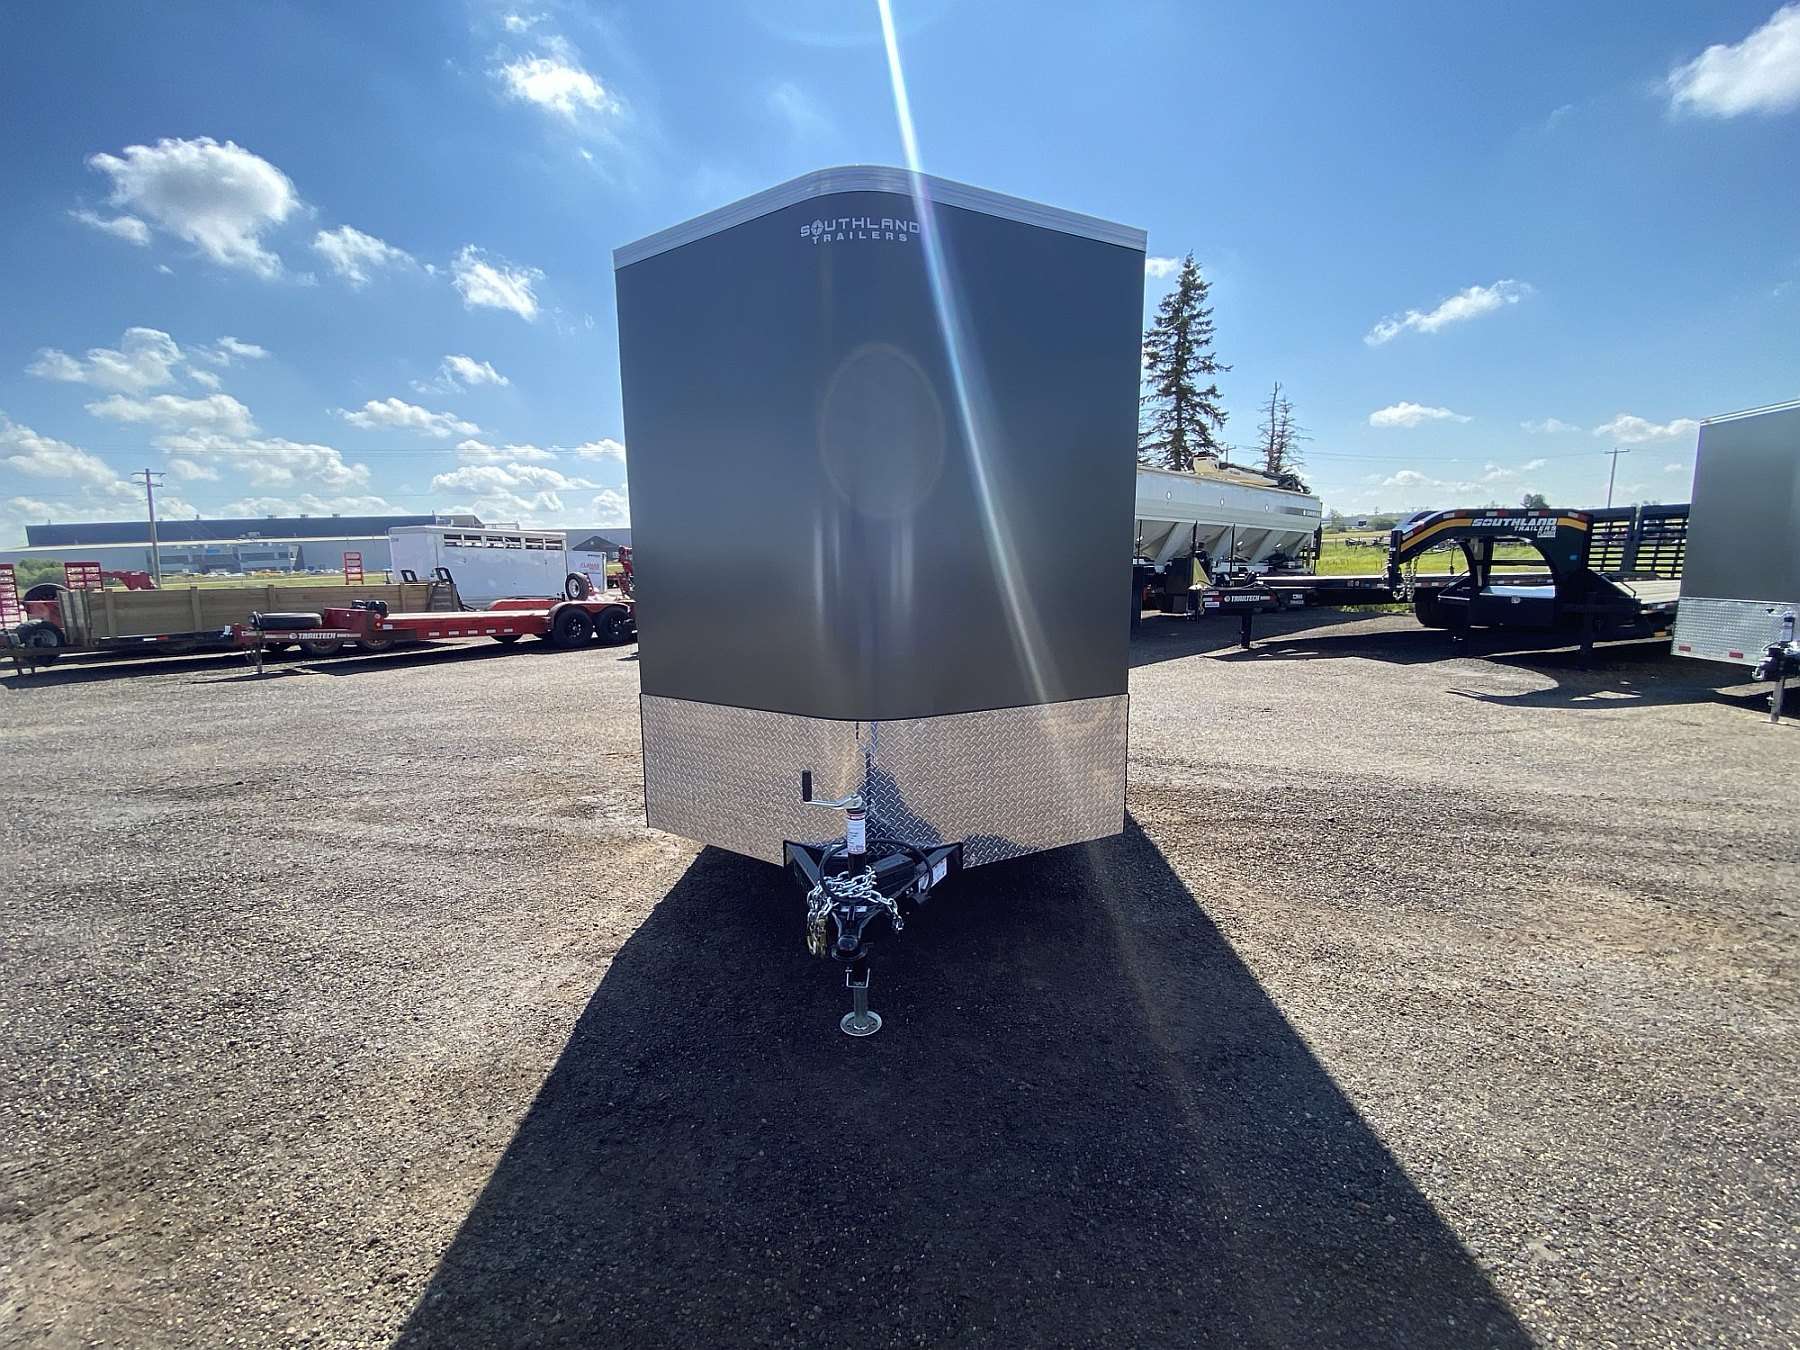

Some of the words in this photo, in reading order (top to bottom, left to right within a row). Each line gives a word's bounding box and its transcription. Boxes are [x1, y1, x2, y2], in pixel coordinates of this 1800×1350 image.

[800, 217, 920, 238] SOUTHLAND
[812, 231, 908, 245] TRAILERS
[1472, 517, 1557, 527] SOUTHLAND
